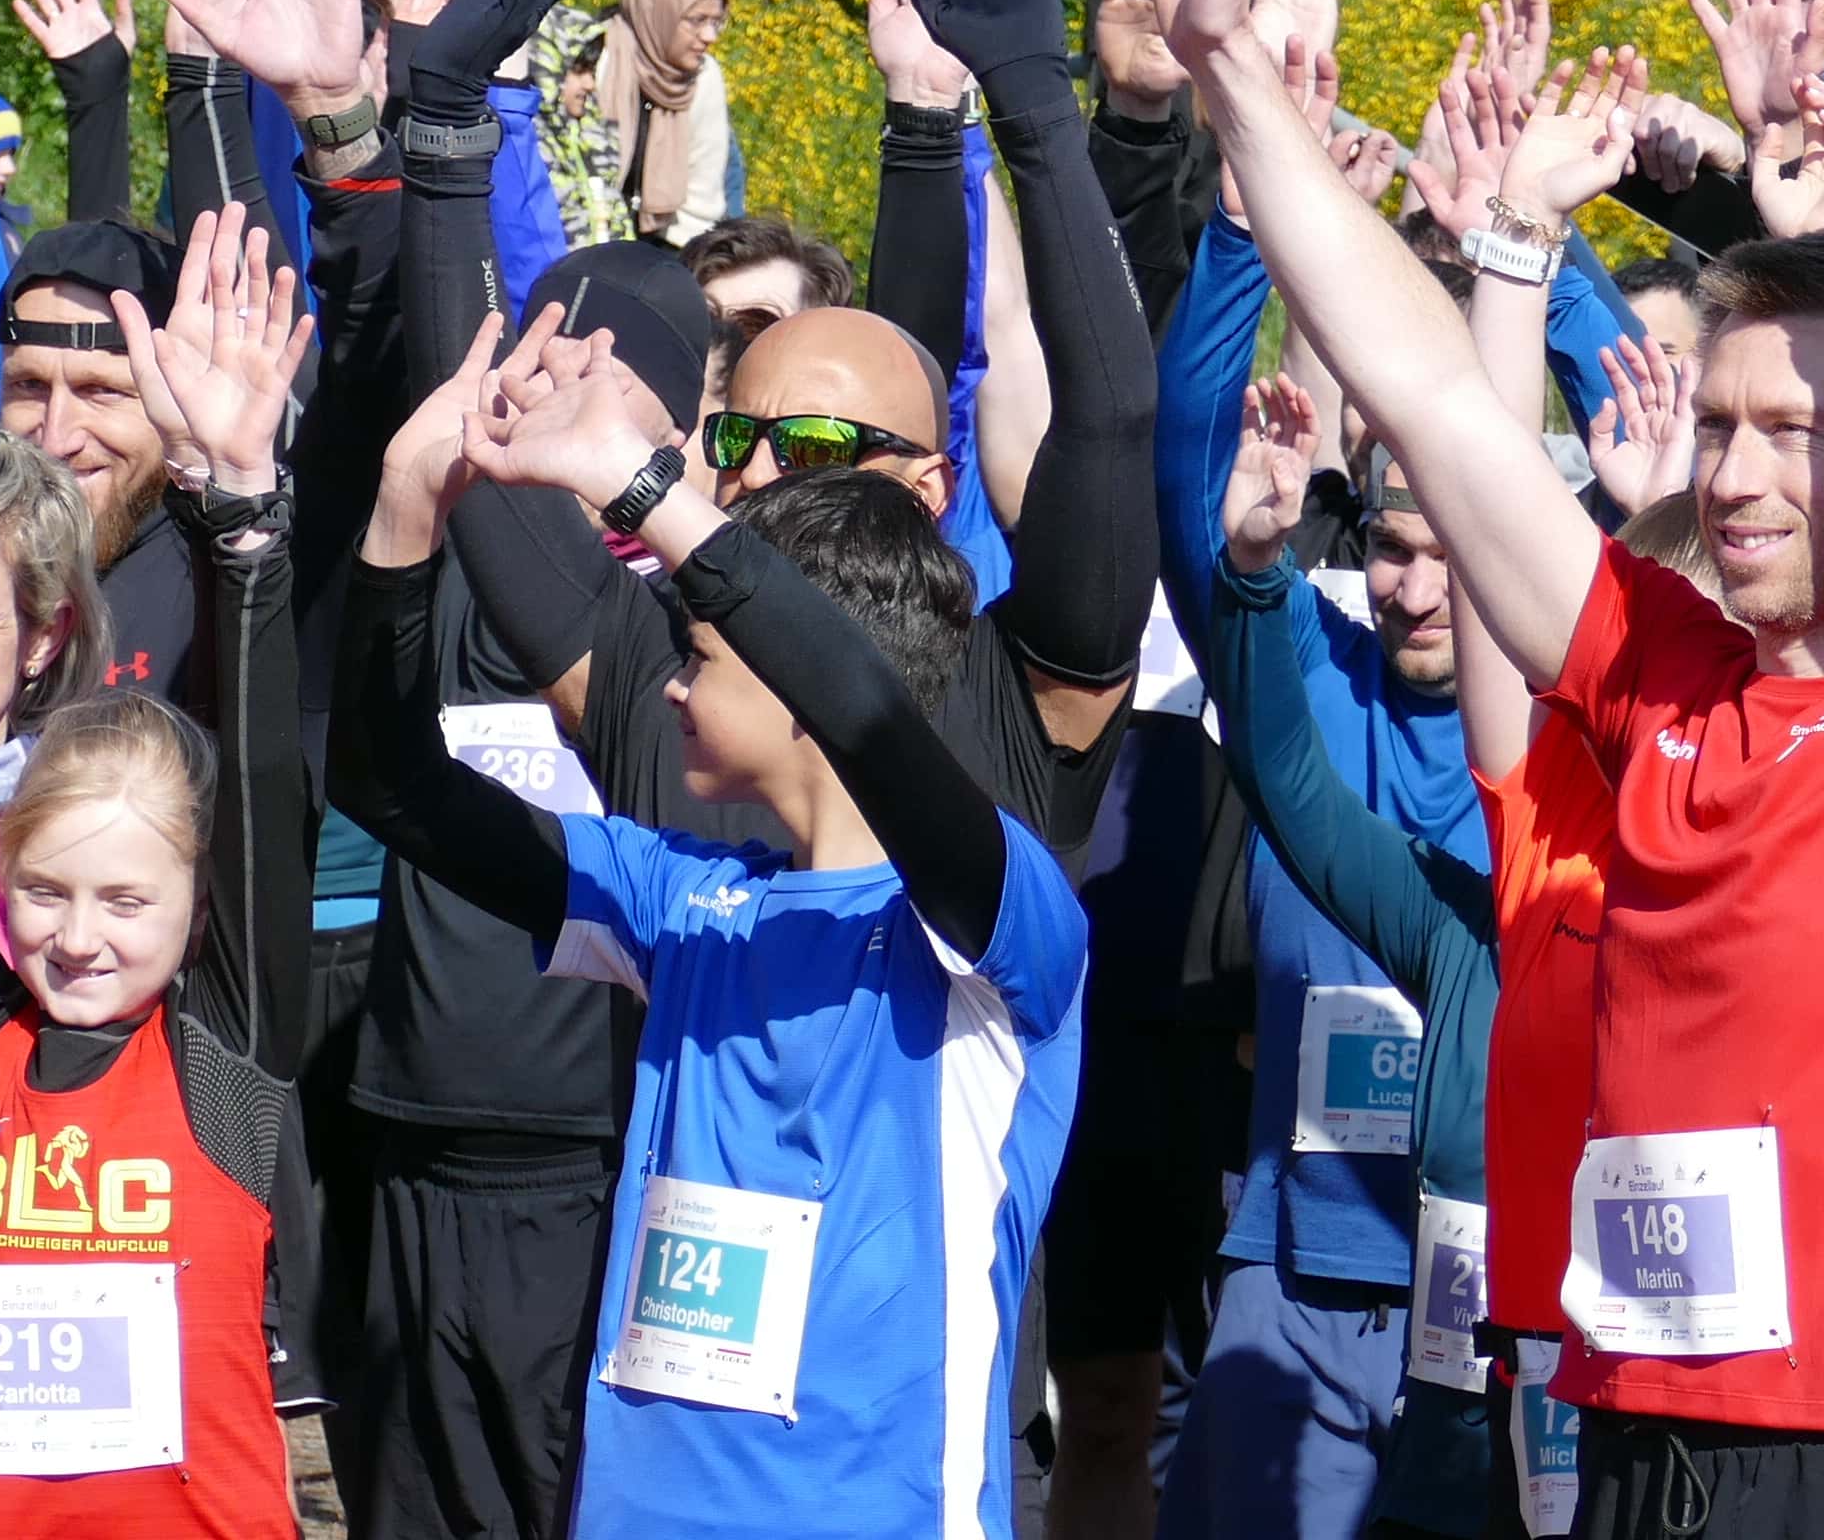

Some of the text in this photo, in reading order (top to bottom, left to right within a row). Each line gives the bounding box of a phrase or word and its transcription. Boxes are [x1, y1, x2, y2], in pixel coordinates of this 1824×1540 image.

[481, 748, 556, 791] 236
[1372, 1040, 1421, 1081] 68
[86, 1240, 169, 1253] LAUFCLUB
[1621, 1204, 1688, 1255] 148
[658, 1238, 722, 1296] 124
[1636, 1268, 1683, 1289] Martin
[641, 1296, 733, 1332] Christopher
